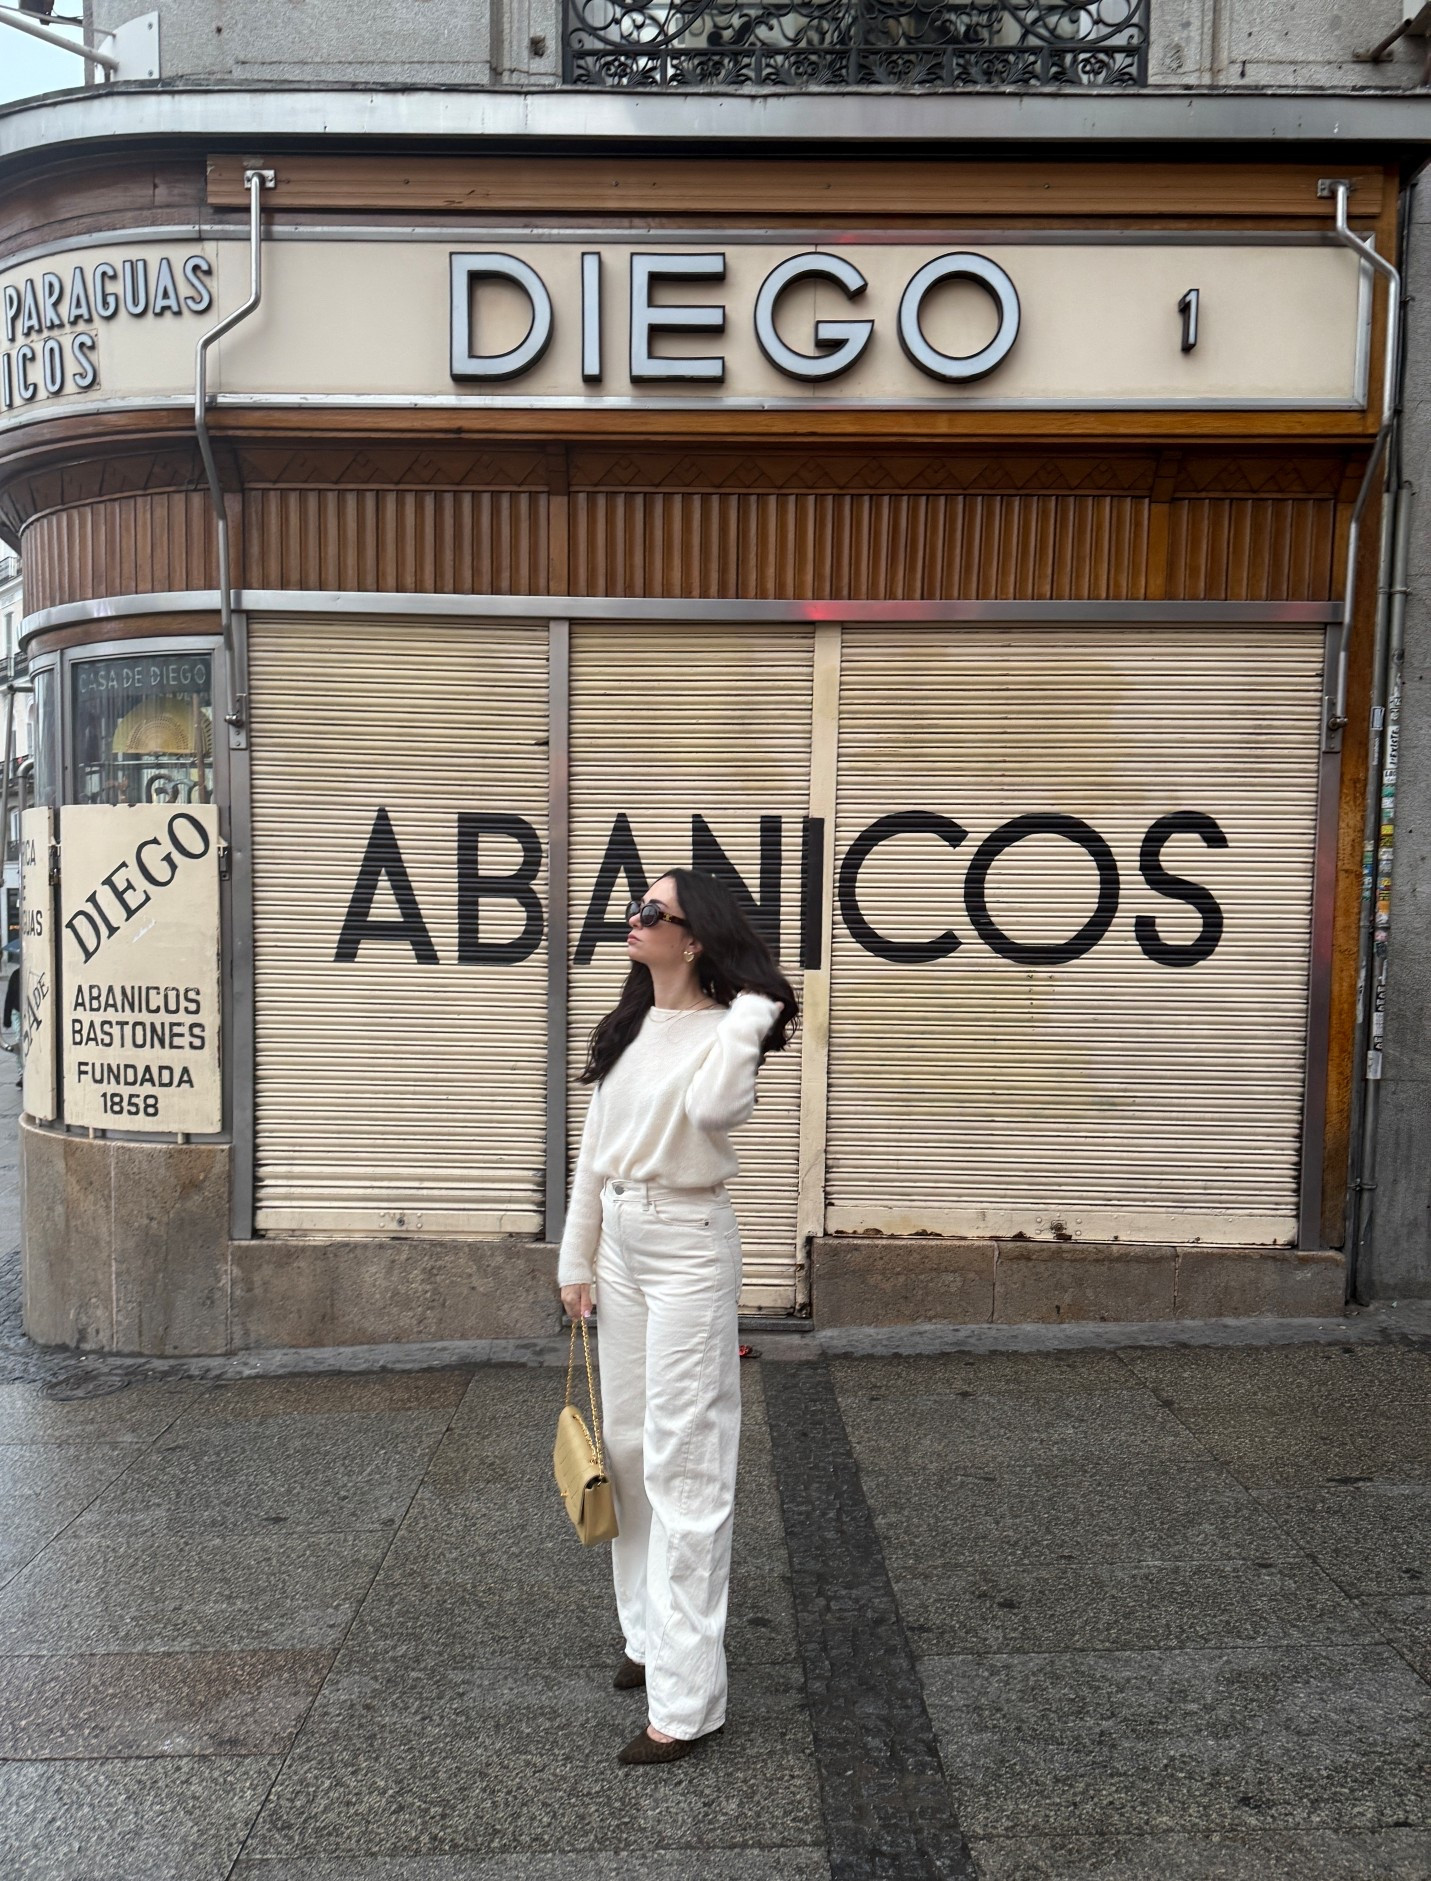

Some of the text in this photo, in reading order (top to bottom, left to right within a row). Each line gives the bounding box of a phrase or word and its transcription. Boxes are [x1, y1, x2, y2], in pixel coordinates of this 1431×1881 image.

[4, 255, 213, 342] PARAGUAS
[449, 250, 1022, 384] DIEGO
[1177, 287, 1200, 353] 1
[2, 332, 98, 407] ICOS
[80, 664, 206, 693] CASA DE DIEGO
[65, 812, 210, 964] DIEGO
[332, 806, 1228, 970] ABANICOS
[73, 984, 201, 1016] ABANICOS
[72, 1018, 206, 1051] BASTONES
[77, 1062, 195, 1089] FUNDADA
[100, 1092, 159, 1117] 1858
